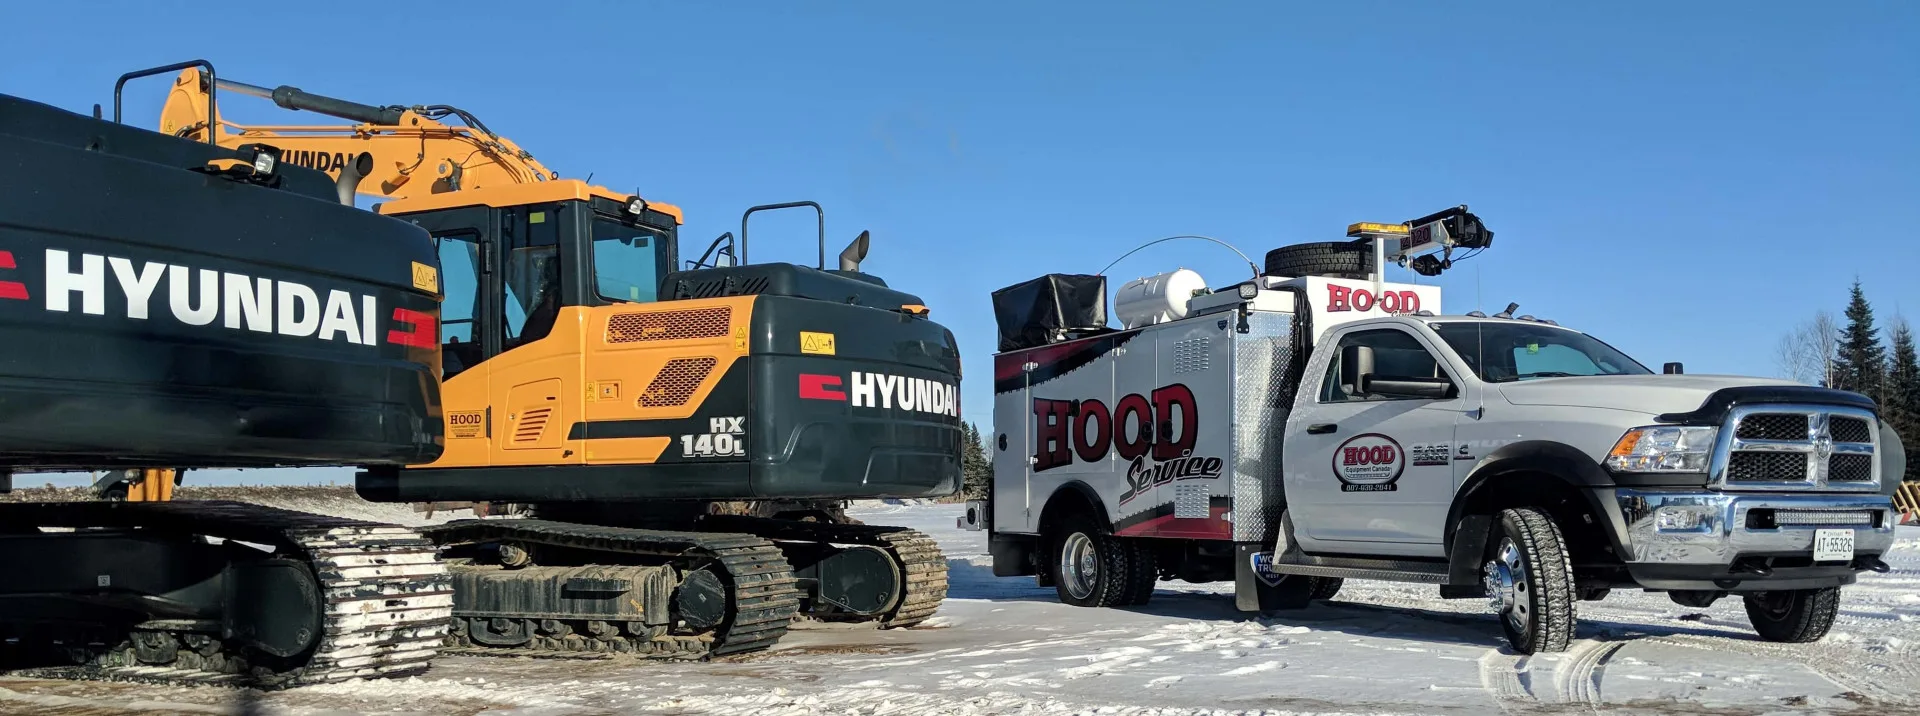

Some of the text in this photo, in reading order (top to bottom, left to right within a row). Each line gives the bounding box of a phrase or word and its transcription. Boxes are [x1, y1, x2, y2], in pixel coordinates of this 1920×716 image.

[45, 248, 377, 346] HYUNDAI
[1326, 283, 1420, 314] HOOD
[851, 371, 957, 417] HYUNDAI
[450, 414, 482, 425] HOOD
[710, 416, 745, 434] HX
[1033, 383, 1198, 473] HOOD
[1343, 445, 1396, 466] HOOD
[1119, 449, 1223, 507] Service
